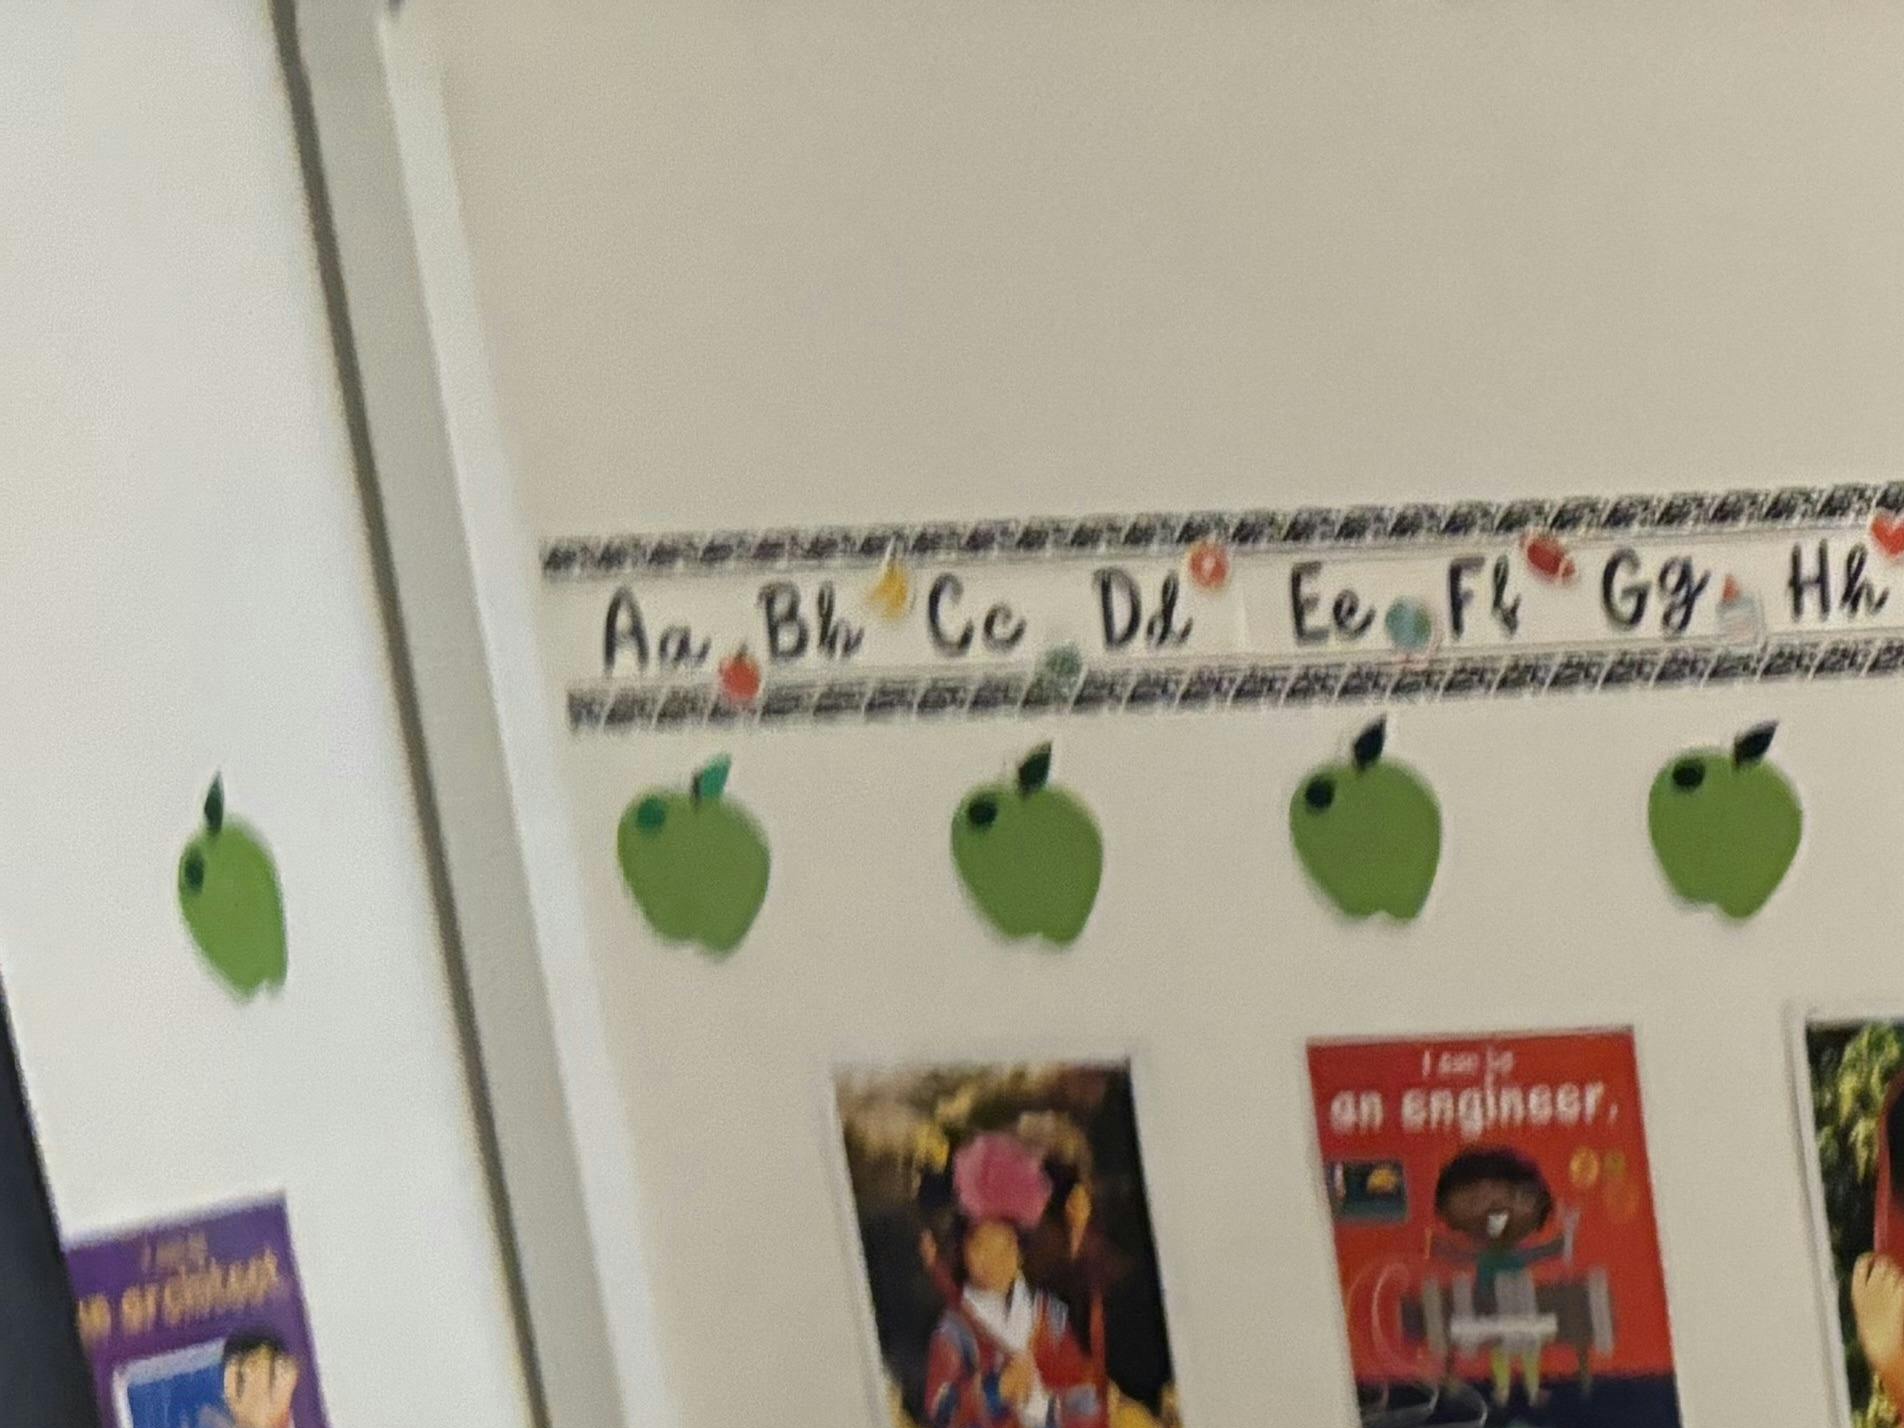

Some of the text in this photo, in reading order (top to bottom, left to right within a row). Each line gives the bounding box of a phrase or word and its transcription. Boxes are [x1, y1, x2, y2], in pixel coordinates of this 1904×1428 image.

[605, 586, 709, 673] Aa
[928, 573, 1026, 656] Cc
[1291, 562, 1375, 644] Ee
[1600, 547, 1709, 636] Gg
[1791, 541, 1891, 620] Hh
[1330, 1089, 1385, 1134] an
